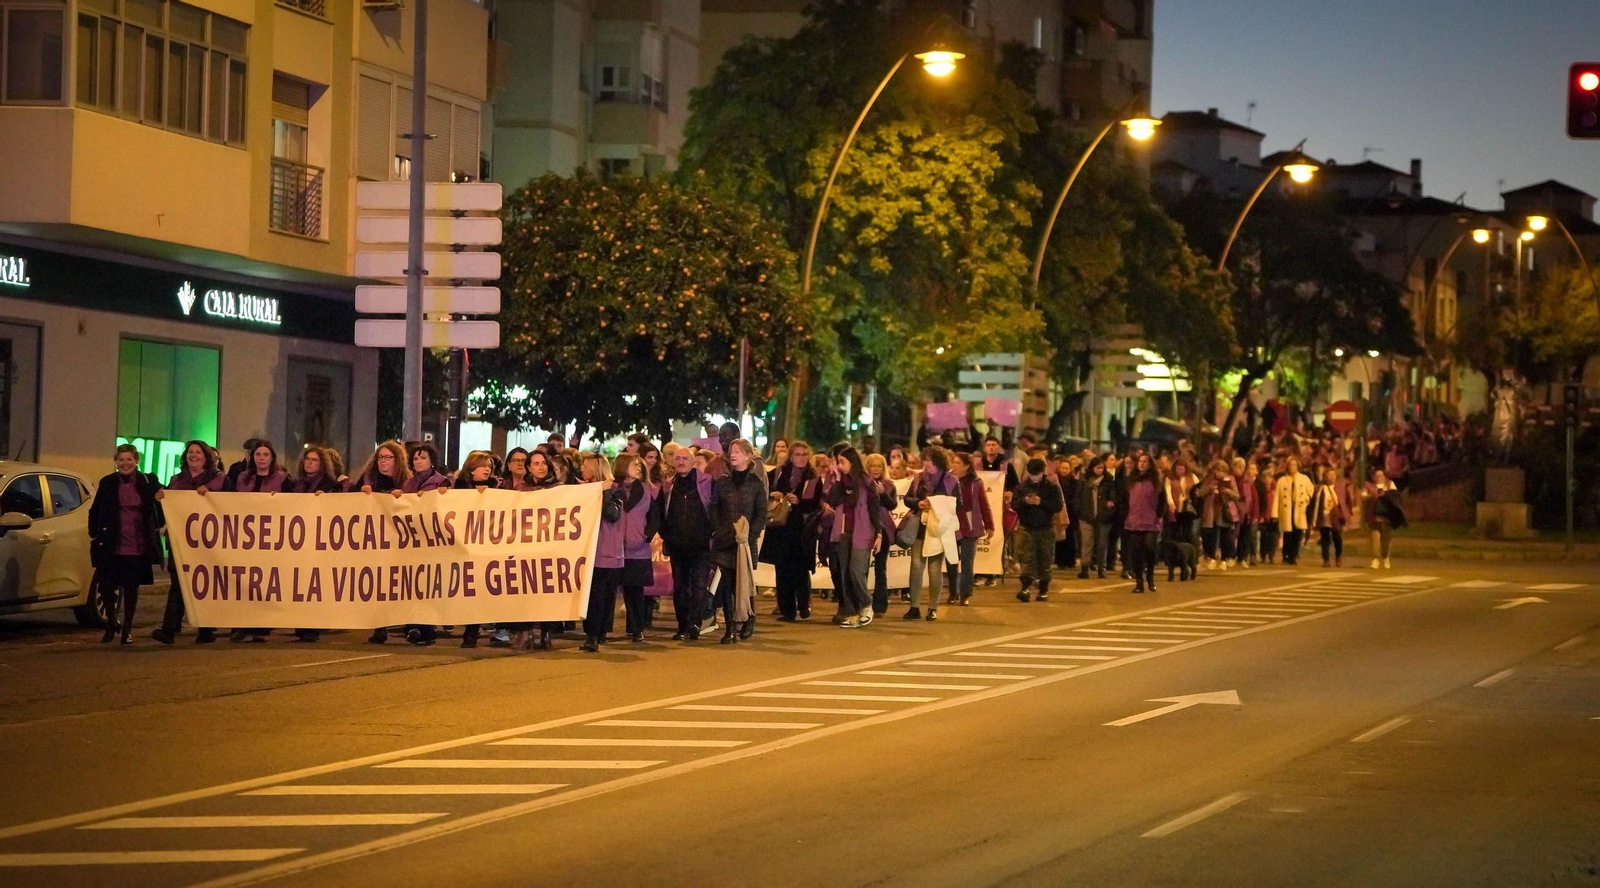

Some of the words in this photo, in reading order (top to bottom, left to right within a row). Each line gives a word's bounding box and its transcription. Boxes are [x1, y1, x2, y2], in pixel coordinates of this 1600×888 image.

[0, 256, 30, 286] RAL
[204, 289, 237, 317] CAJA
[239, 293, 281, 324] RURAL
[185, 512, 306, 551] CONSEJO
[315, 514, 391, 551] LOCAL
[392, 514, 420, 549] DE
[419, 511, 456, 548] LAS
[463, 505, 582, 545] MUJERES
[182, 563, 282, 602] ONTRA
[292, 567, 322, 602] LA
[332, 563, 442, 602] VIOLENCIA
[447, 561, 476, 598] DE
